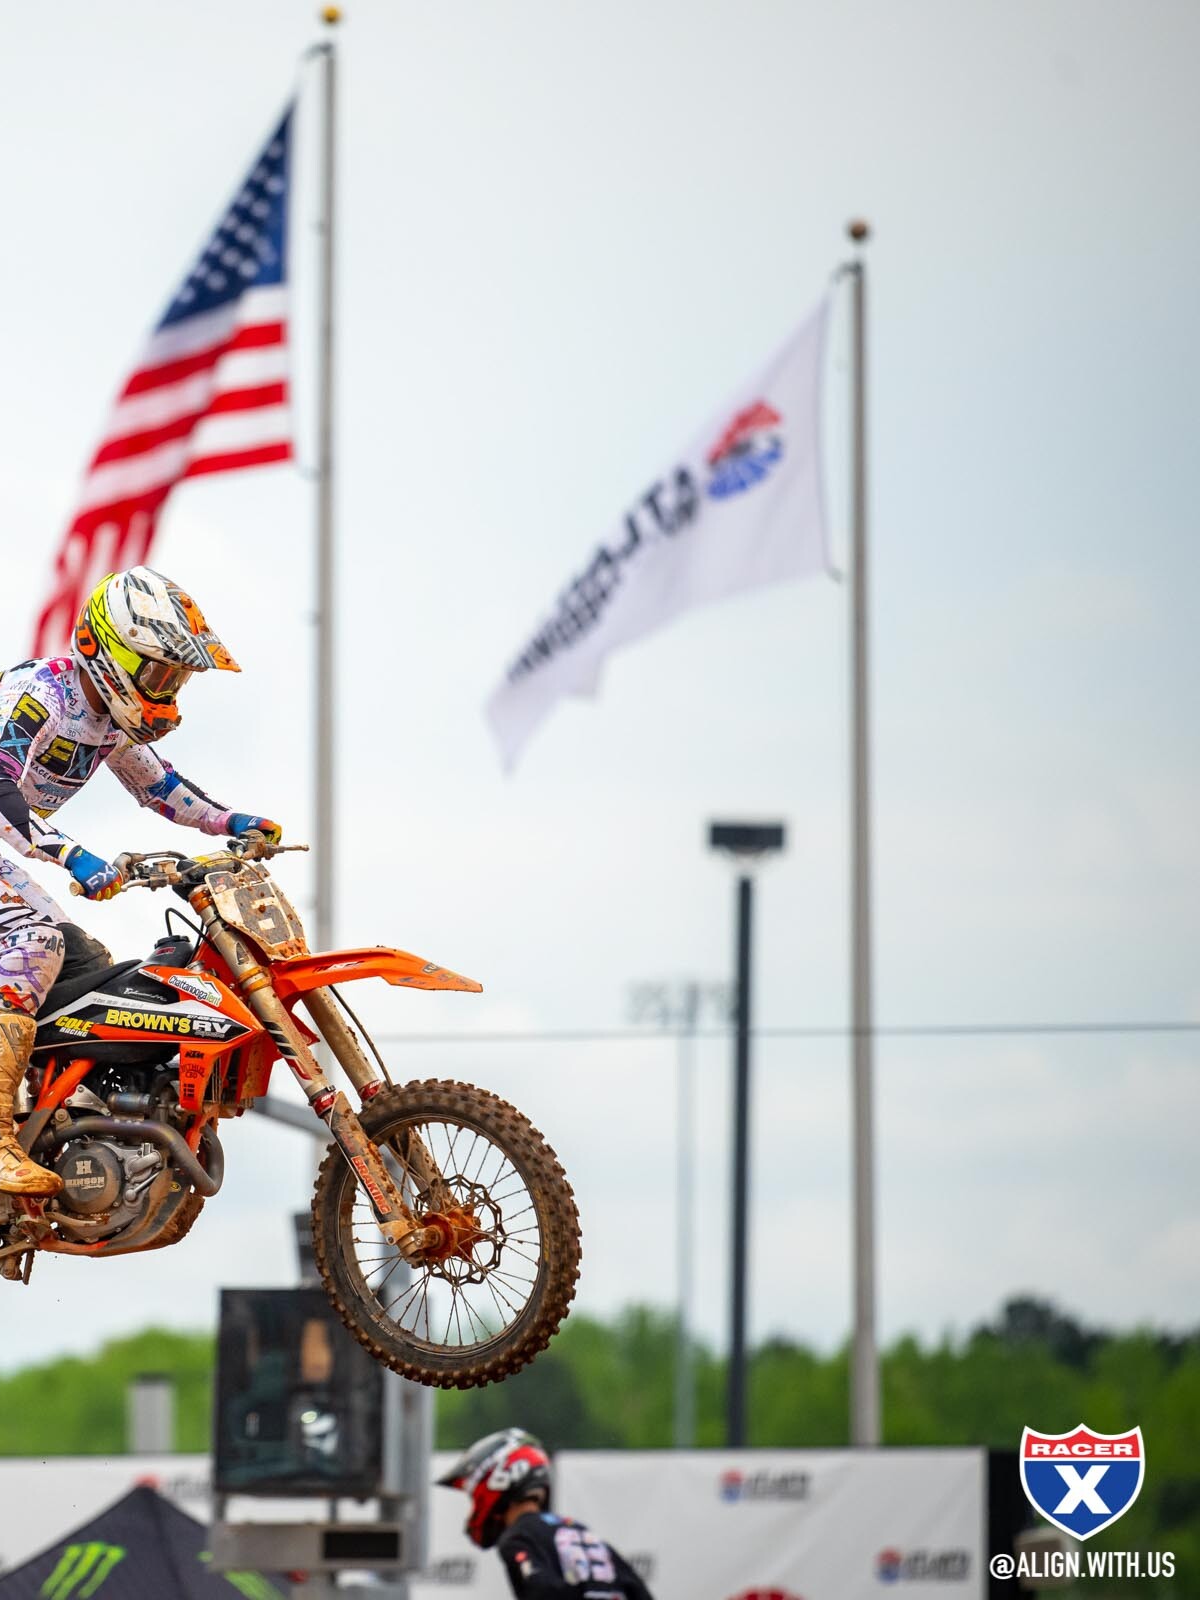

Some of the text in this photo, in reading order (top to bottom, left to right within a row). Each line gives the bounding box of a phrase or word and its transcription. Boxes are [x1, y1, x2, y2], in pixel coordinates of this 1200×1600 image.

[55, 1015, 93, 1031] COLE
[105, 1009, 191, 1033] BROWN'S
[192, 1019, 232, 1034] RV
[59, 1027, 88, 1037] RACING
[352, 1156, 392, 1214] BRAKING
